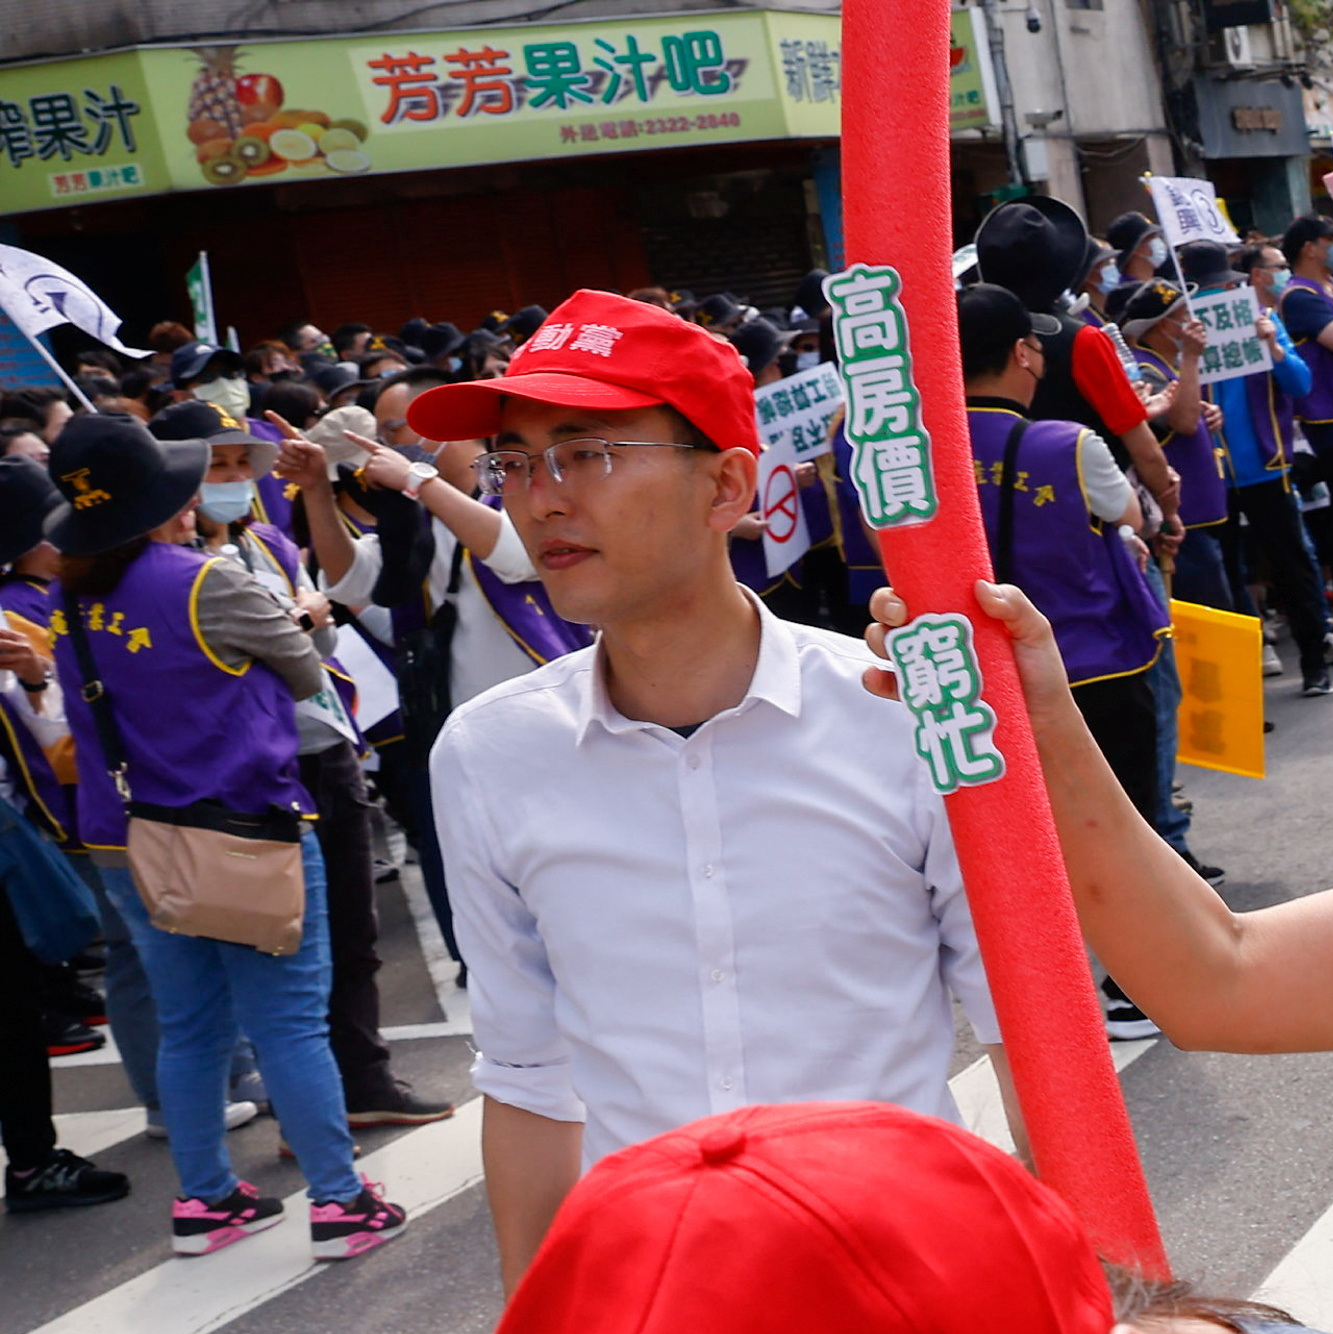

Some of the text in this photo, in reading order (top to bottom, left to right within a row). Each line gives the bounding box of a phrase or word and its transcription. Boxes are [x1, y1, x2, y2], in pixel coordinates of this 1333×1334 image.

[367, 30, 731, 125] 芳芳果汁吧
[513, 322, 624, 358] 動黨
[832, 273, 930, 520] 高房價
[896, 624, 995, 786] 窮忙
